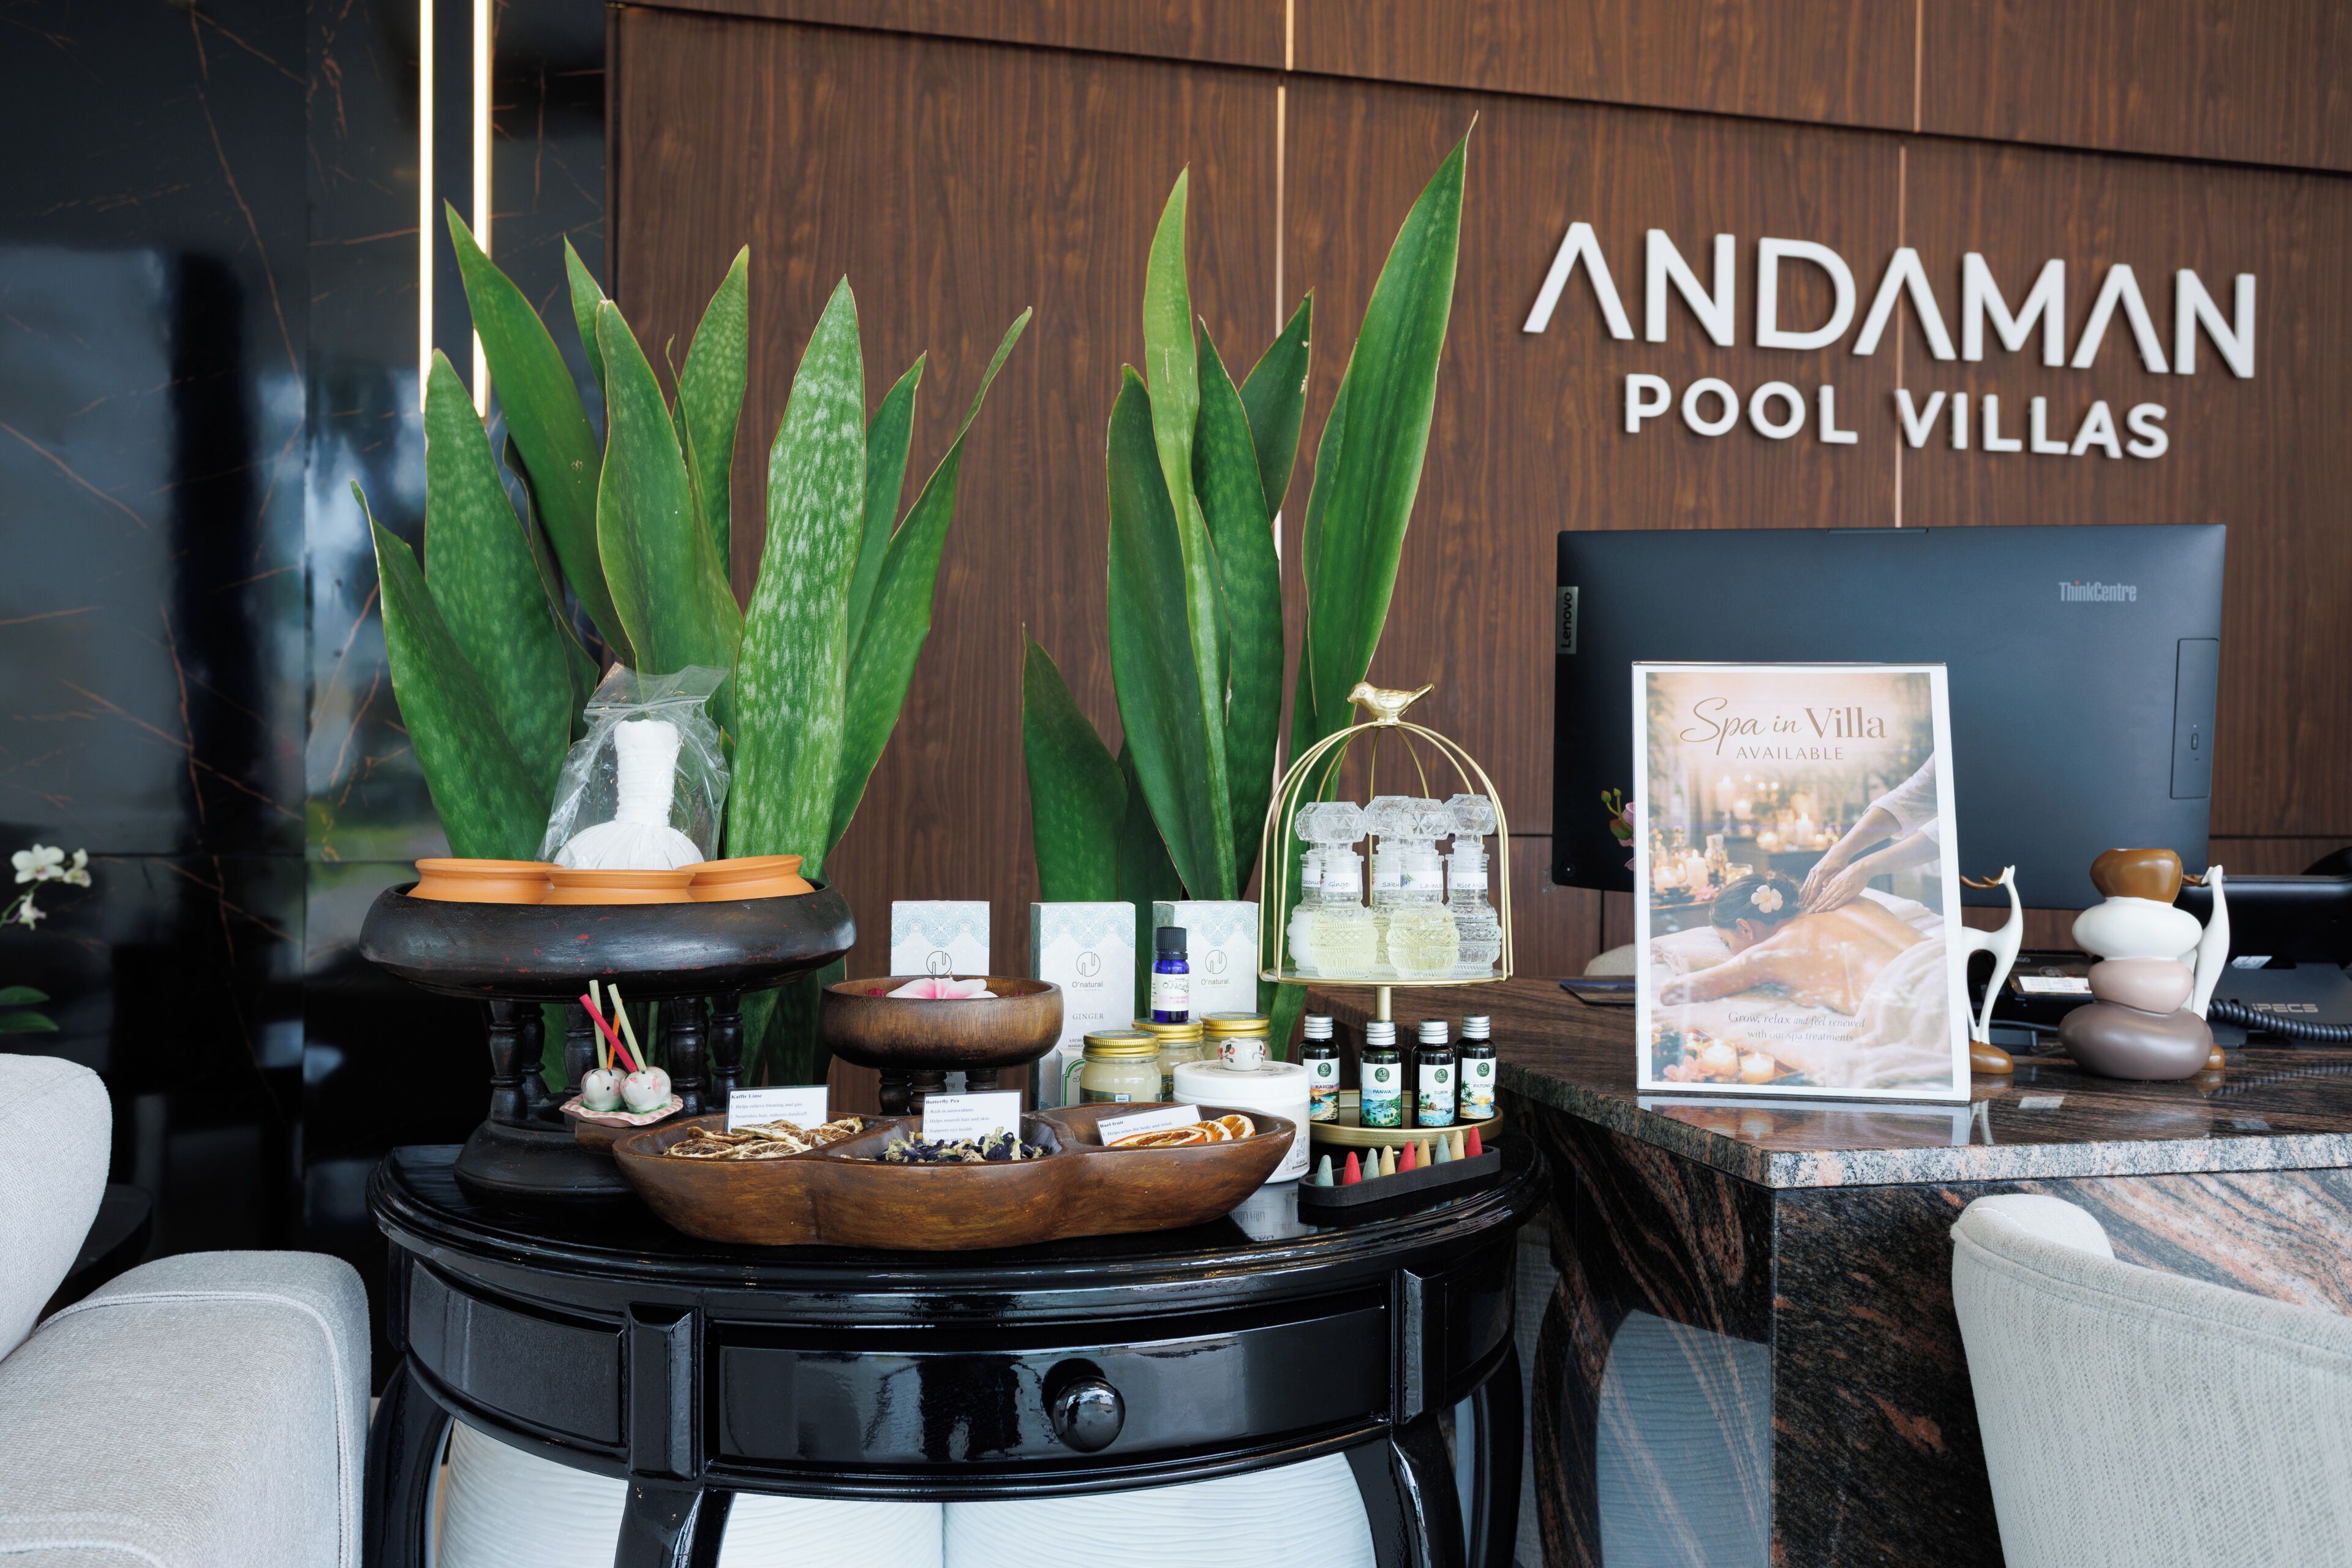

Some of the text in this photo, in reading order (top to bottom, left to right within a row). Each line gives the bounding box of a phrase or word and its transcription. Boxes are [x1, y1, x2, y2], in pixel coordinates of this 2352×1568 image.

[1523, 222, 2256, 378] ANDAMAN
[1625, 374, 2169, 459] POOL VILLAS
[2059, 580, 2137, 601] ThinkCentre
[1561, 592, 1572, 647] Lenovo
[1680, 697, 1887, 756] Spa in Villa
[1736, 747, 1844, 760] AVAILABLE
[1728, 1011, 1865, 1028] Grow, relax and feel renewed
[1747, 1030, 1766, 1038] with
[1787, 1033, 1802, 1042] spa
